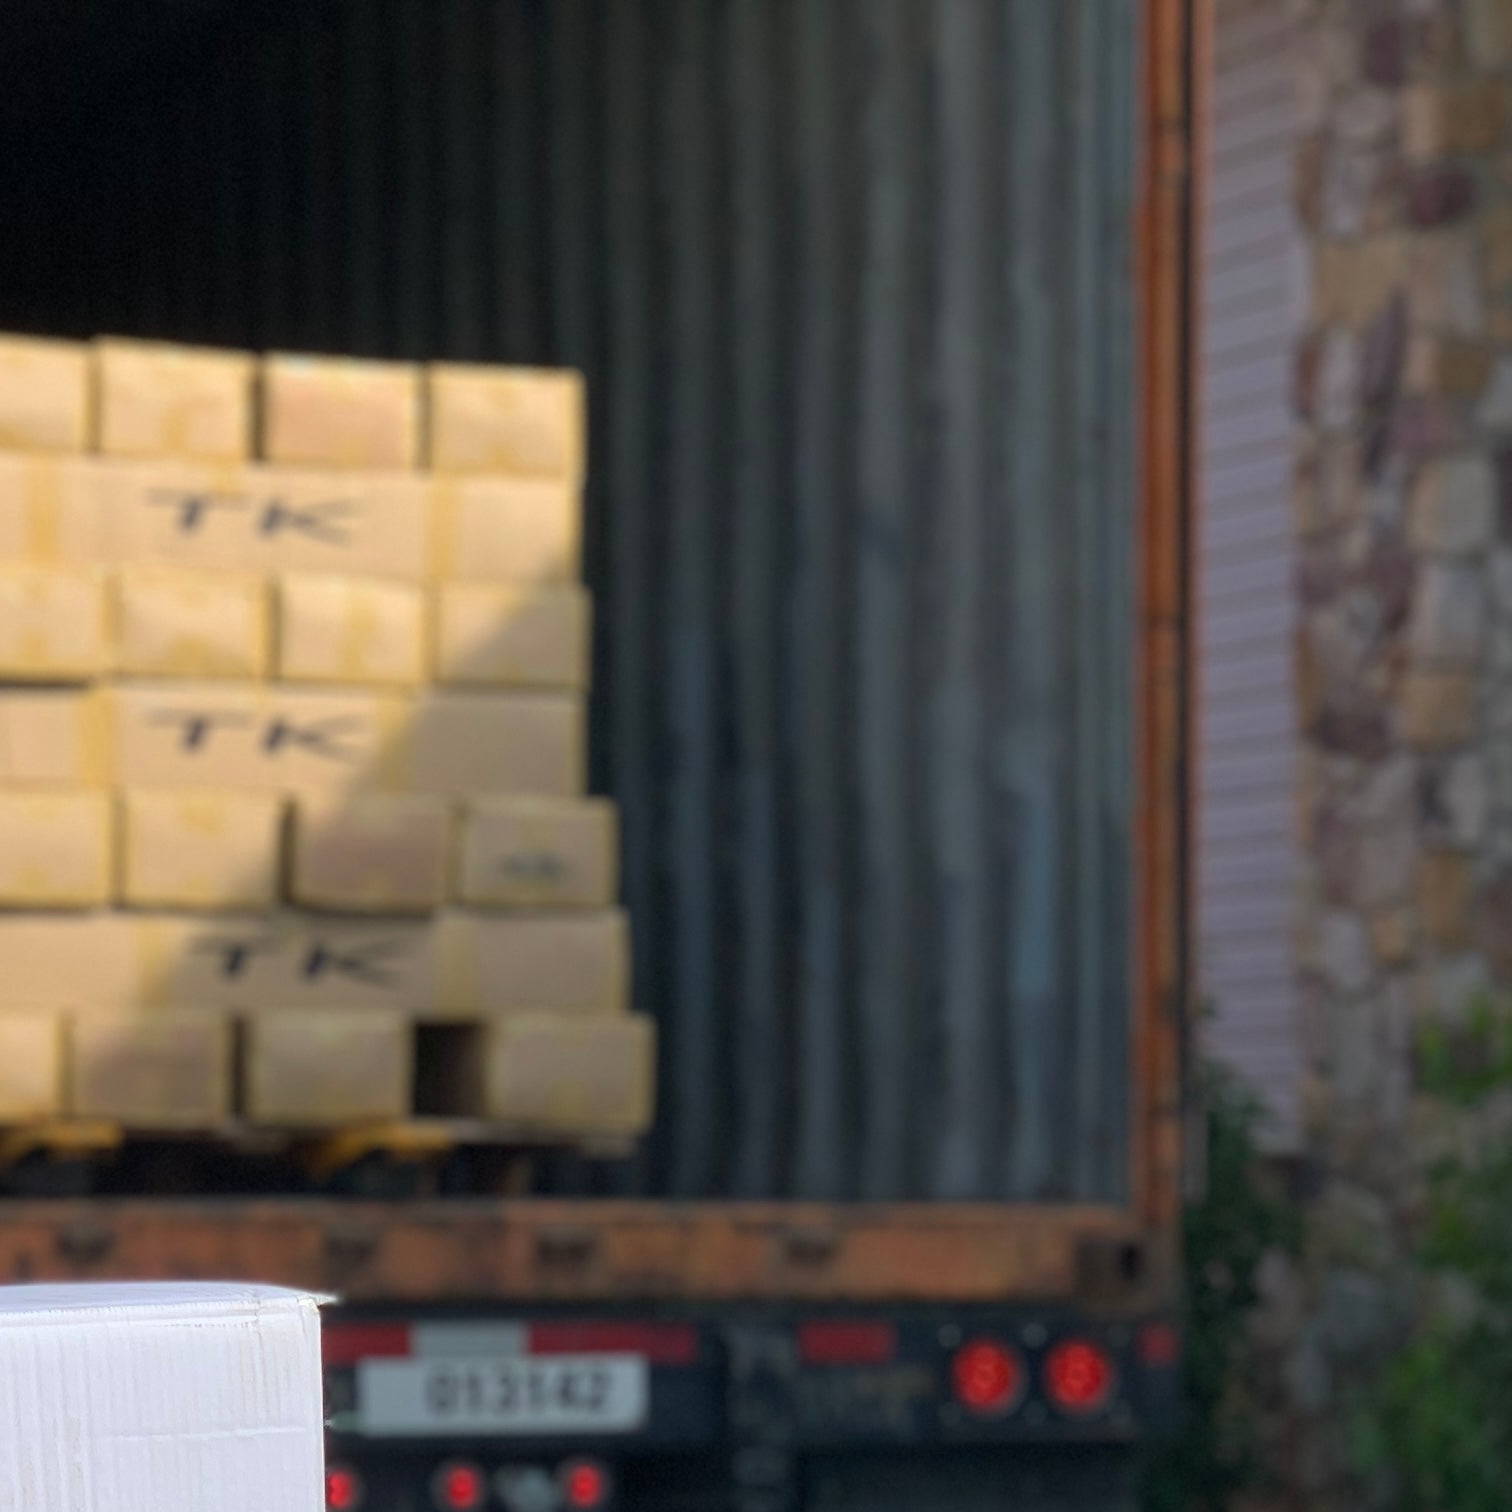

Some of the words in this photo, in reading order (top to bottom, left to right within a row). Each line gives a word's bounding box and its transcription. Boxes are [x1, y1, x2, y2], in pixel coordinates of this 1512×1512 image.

[144, 488, 366, 546] TK
[144, 707, 370, 763] TK
[190, 934, 412, 992] TK
